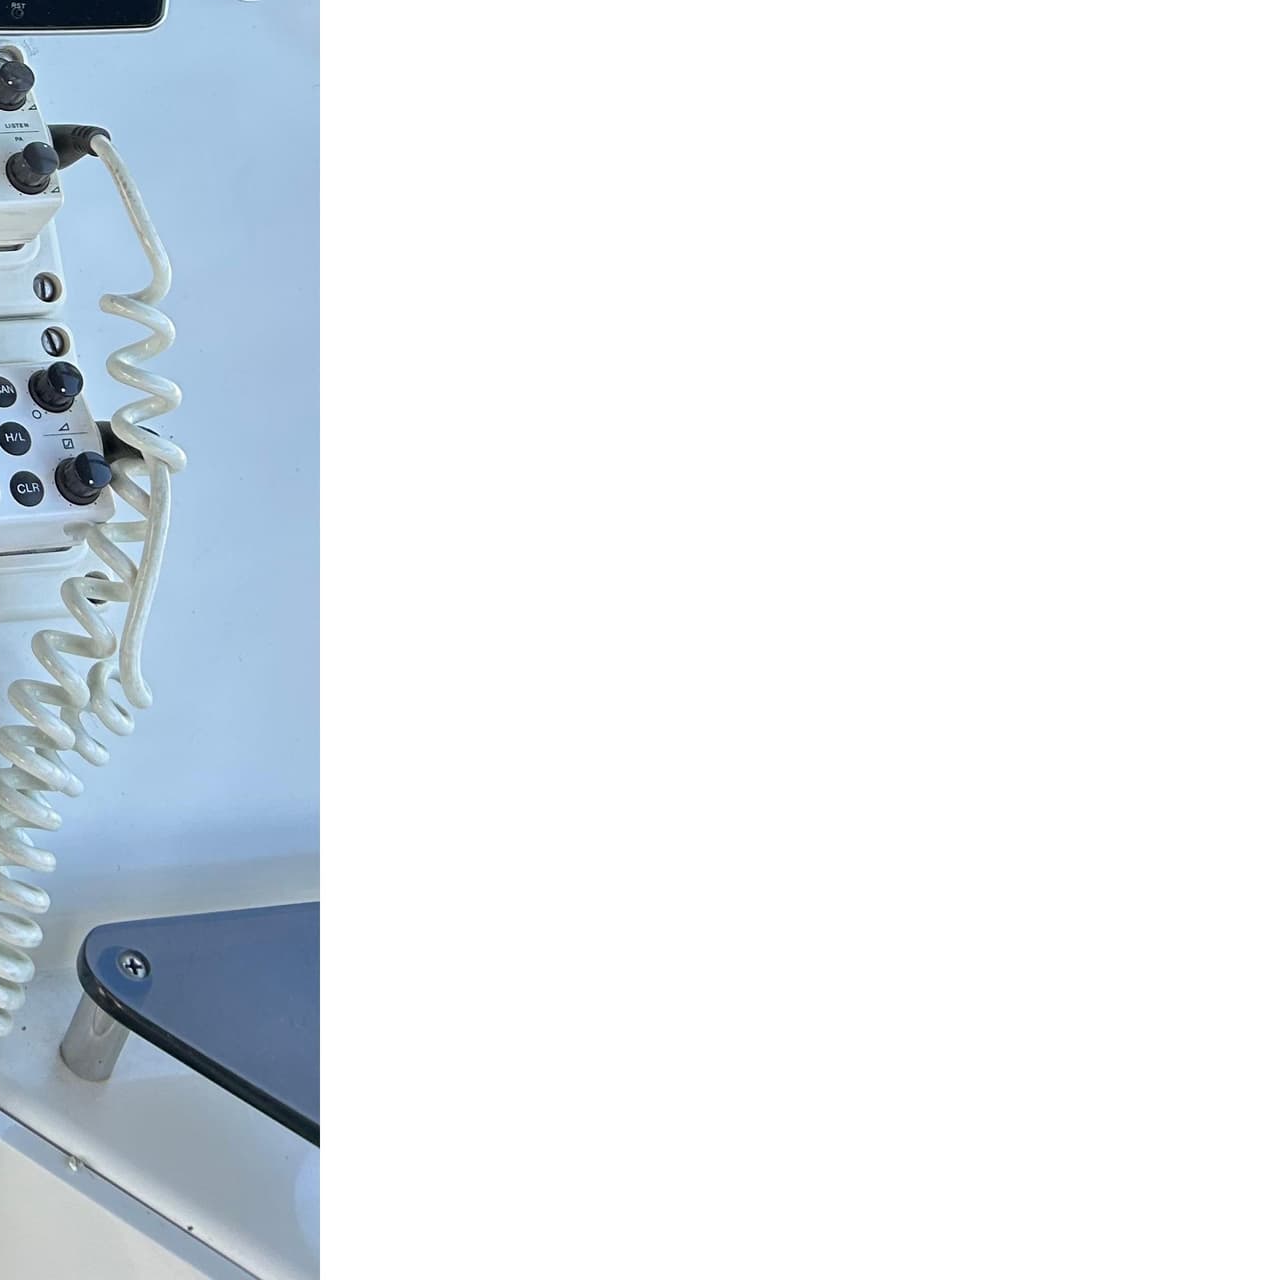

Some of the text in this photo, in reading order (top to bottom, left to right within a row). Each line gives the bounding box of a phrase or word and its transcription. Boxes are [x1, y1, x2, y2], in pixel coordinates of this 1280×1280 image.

[11, 1, 26, 9] RST
[5, 433, 26, 442] H/L
[16, 483, 40, 494] CLR
